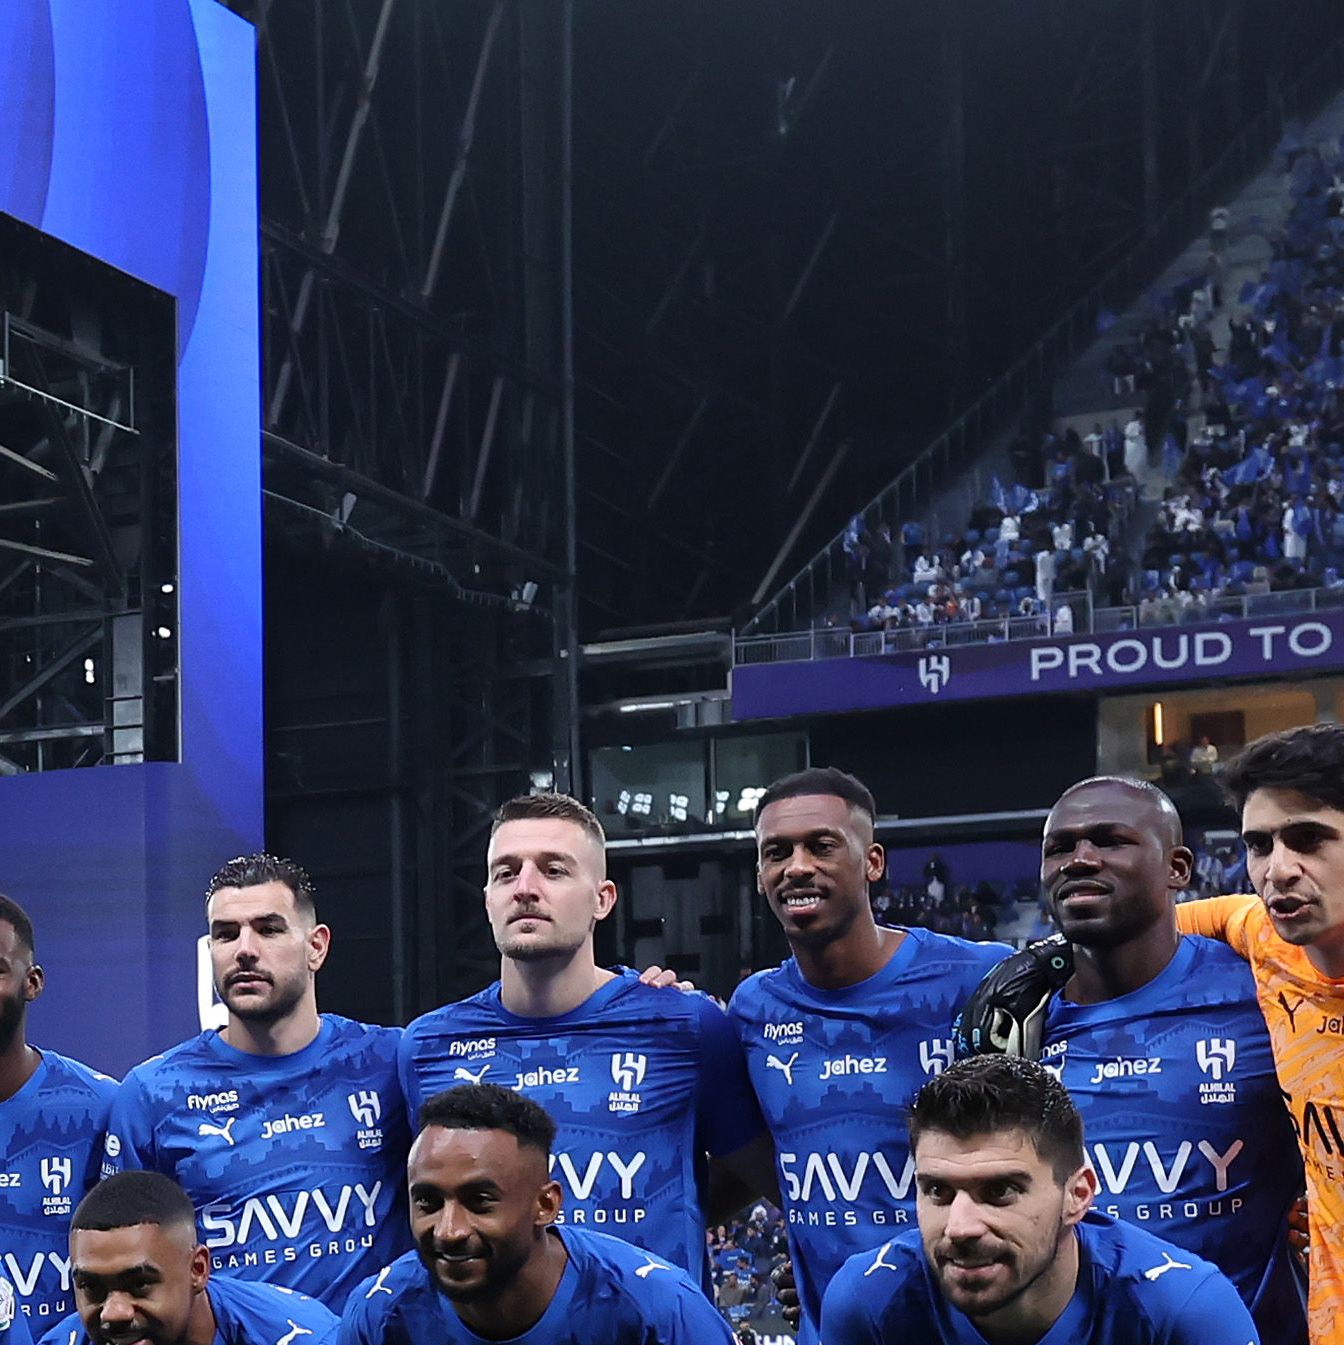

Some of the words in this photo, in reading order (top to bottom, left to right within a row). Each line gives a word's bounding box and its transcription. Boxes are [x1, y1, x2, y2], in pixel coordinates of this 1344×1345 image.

[1030, 631, 1233, 681] PROUD
[1249, 622, 1333, 661] TO
[764, 1021, 804, 1040] flynas
[449, 1038, 496, 1056] flynas
[1042, 1040, 1068, 1058] nas
[608, 1092, 641, 1102] ALHILAL
[1199, 1083, 1236, 1093] ALHILAL
[187, 1090, 239, 1111] flynas
[780, 1151, 917, 1202] SAVV
[202, 1180, 383, 1249] SAVVY
[788, 1208, 857, 1226] GAMES
[1136, 1198, 1244, 1220] GROUP
[212, 1246, 297, 1270] GAMES
[309, 1234, 373, 1258] GROU
[21, 1299, 66, 1317] ROU
